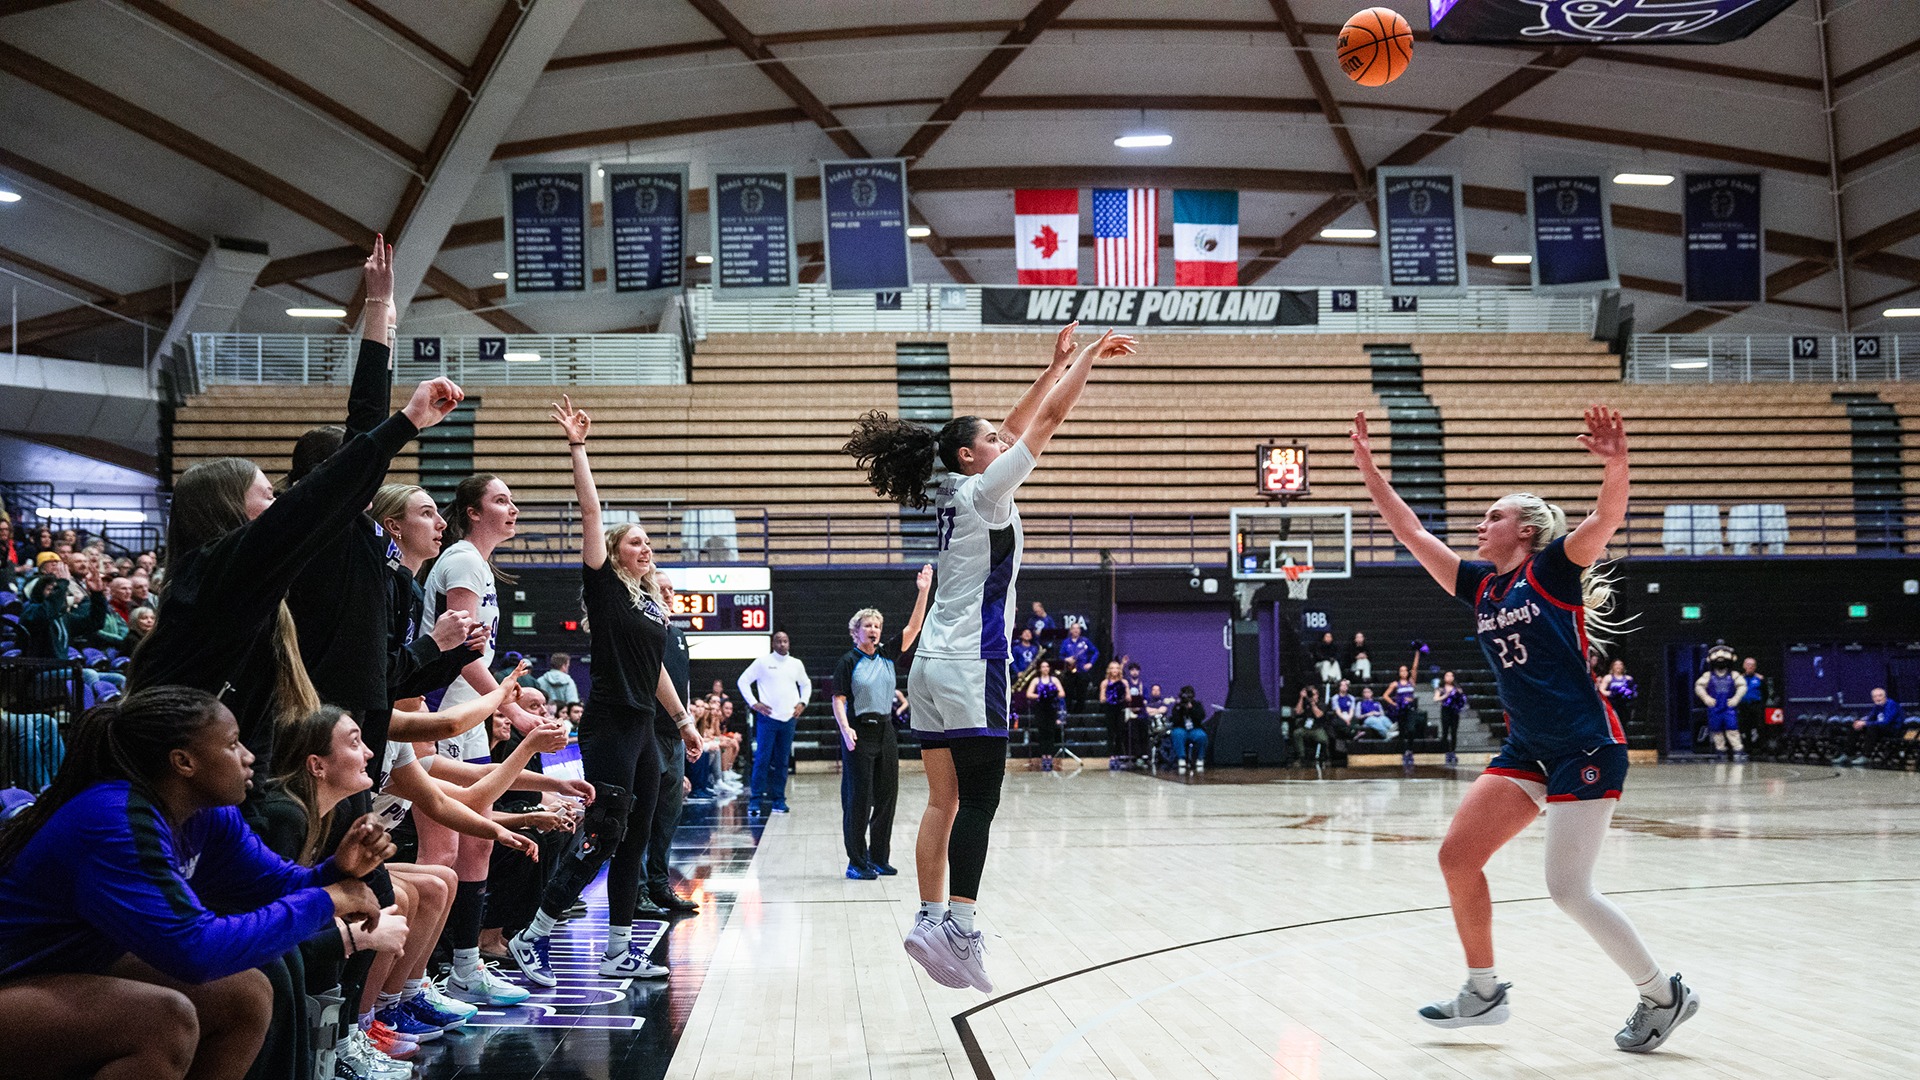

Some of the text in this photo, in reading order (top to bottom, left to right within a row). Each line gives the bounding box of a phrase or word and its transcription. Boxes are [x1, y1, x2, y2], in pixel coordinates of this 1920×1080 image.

[828, 168, 898, 184] HALL OF FAME
[515, 177, 580, 192] HALL OF FAME
[614, 177, 679, 192] HALL OF FAME
[720, 177, 784, 192] HALL OF FAME
[882, 292, 897, 304] 17
[947, 290, 961, 305] 18
[1338, 293, 1351, 307] 18
[1398, 296, 1413, 308] 19
[1026, 290, 1282, 325] WE ARE PORTLAND
[418, 342, 435, 356] 16
[485, 342, 501, 355] 17
[1797, 339, 1815, 356] 19
[1857, 339, 1878, 355] 20
[1271, 449, 1304, 464] 6:31
[1267, 463, 1300, 490] 23
[672, 594, 715, 614] 6:31
[733, 595, 767, 606] GUEST
[691, 616, 704, 631] 4
[742, 609, 766, 628] 30
[1063, 614, 1088, 630] 18A
[1305, 612, 1328, 628] 18B
[489, 616, 499, 650] 9
[1493, 633, 1528, 668] 23
[1585, 770, 1595, 782] G
